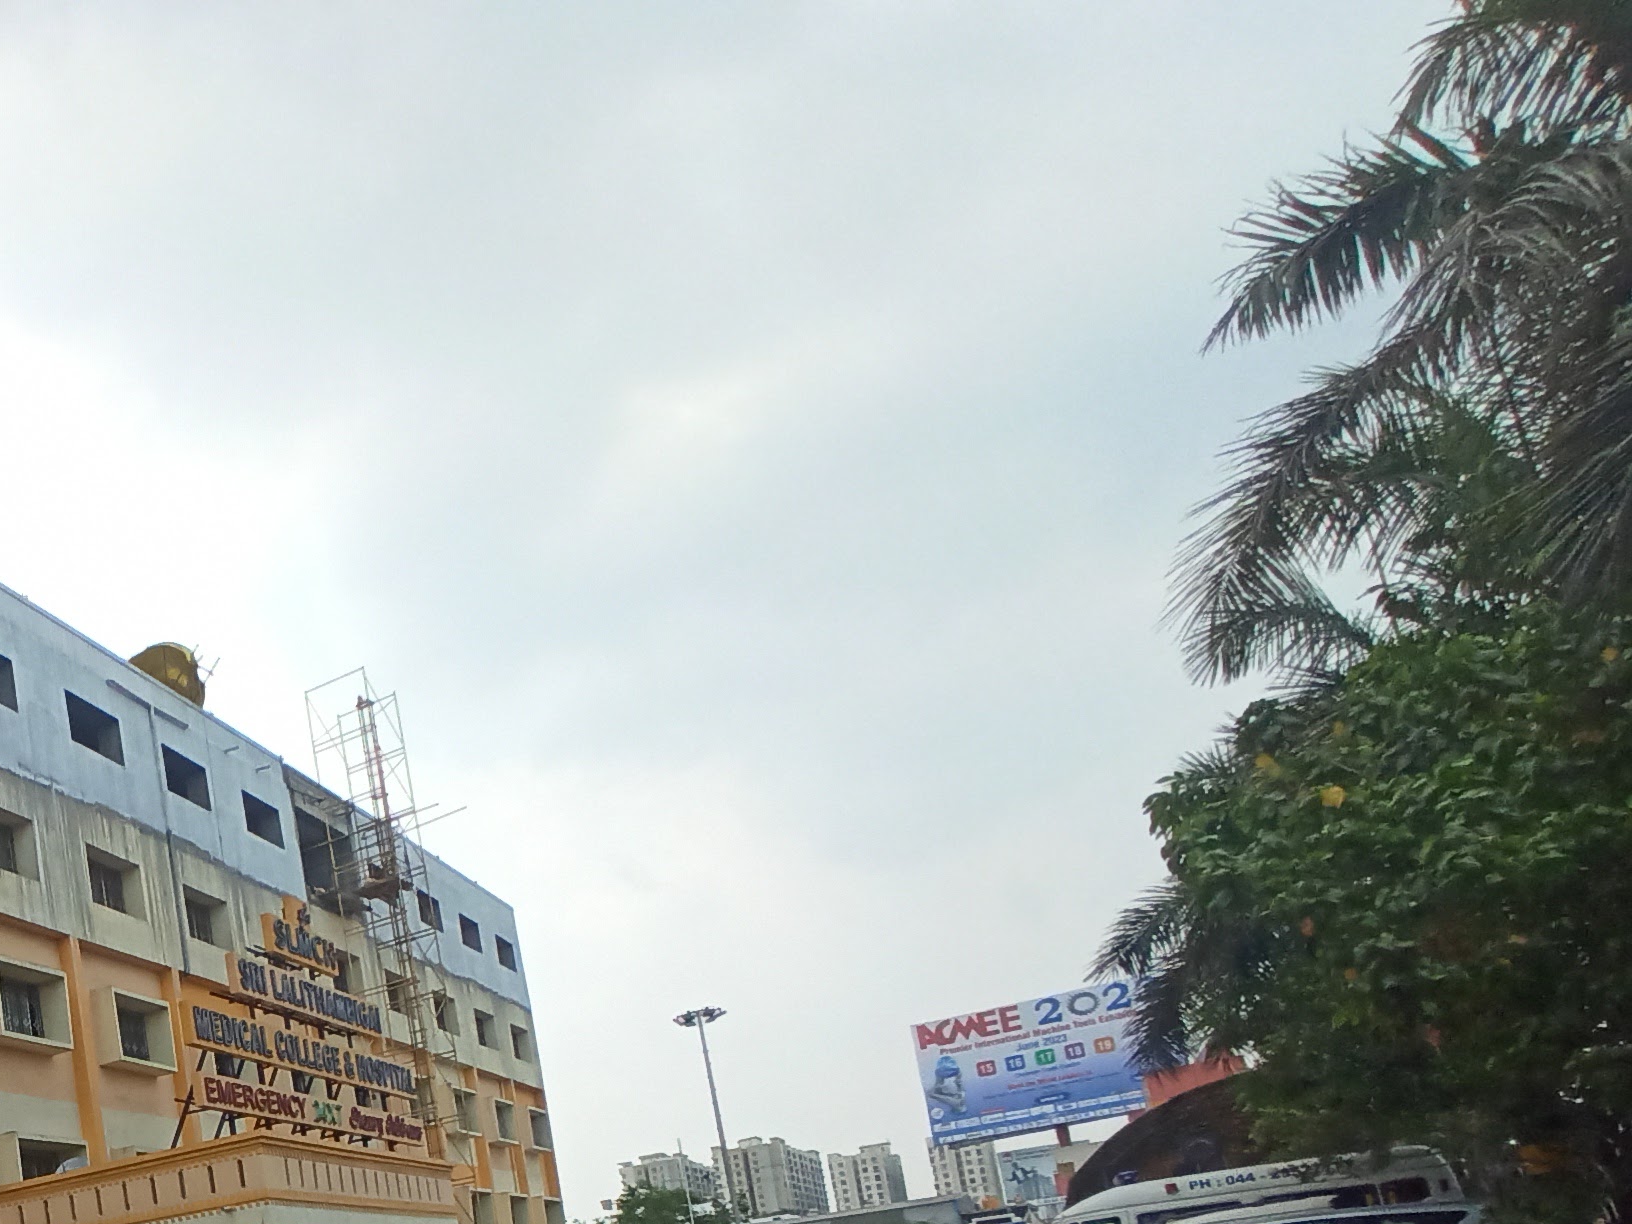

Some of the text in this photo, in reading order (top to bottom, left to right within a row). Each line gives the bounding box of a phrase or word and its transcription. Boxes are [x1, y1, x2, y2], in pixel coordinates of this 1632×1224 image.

[238, 958, 268, 996] SRI
[916, 982, 1132, 1050] ACMEE 202
[1032, 1023, 1071, 1038] Machine
[192, 1005, 417, 1096] MEDICAL COLLEGE & HOSPITAL
[204, 1076, 307, 1120] EMERGENCY
[1189, 1177, 1212, 1191] PH
[1225, 1172, 1256, 1186] 044
